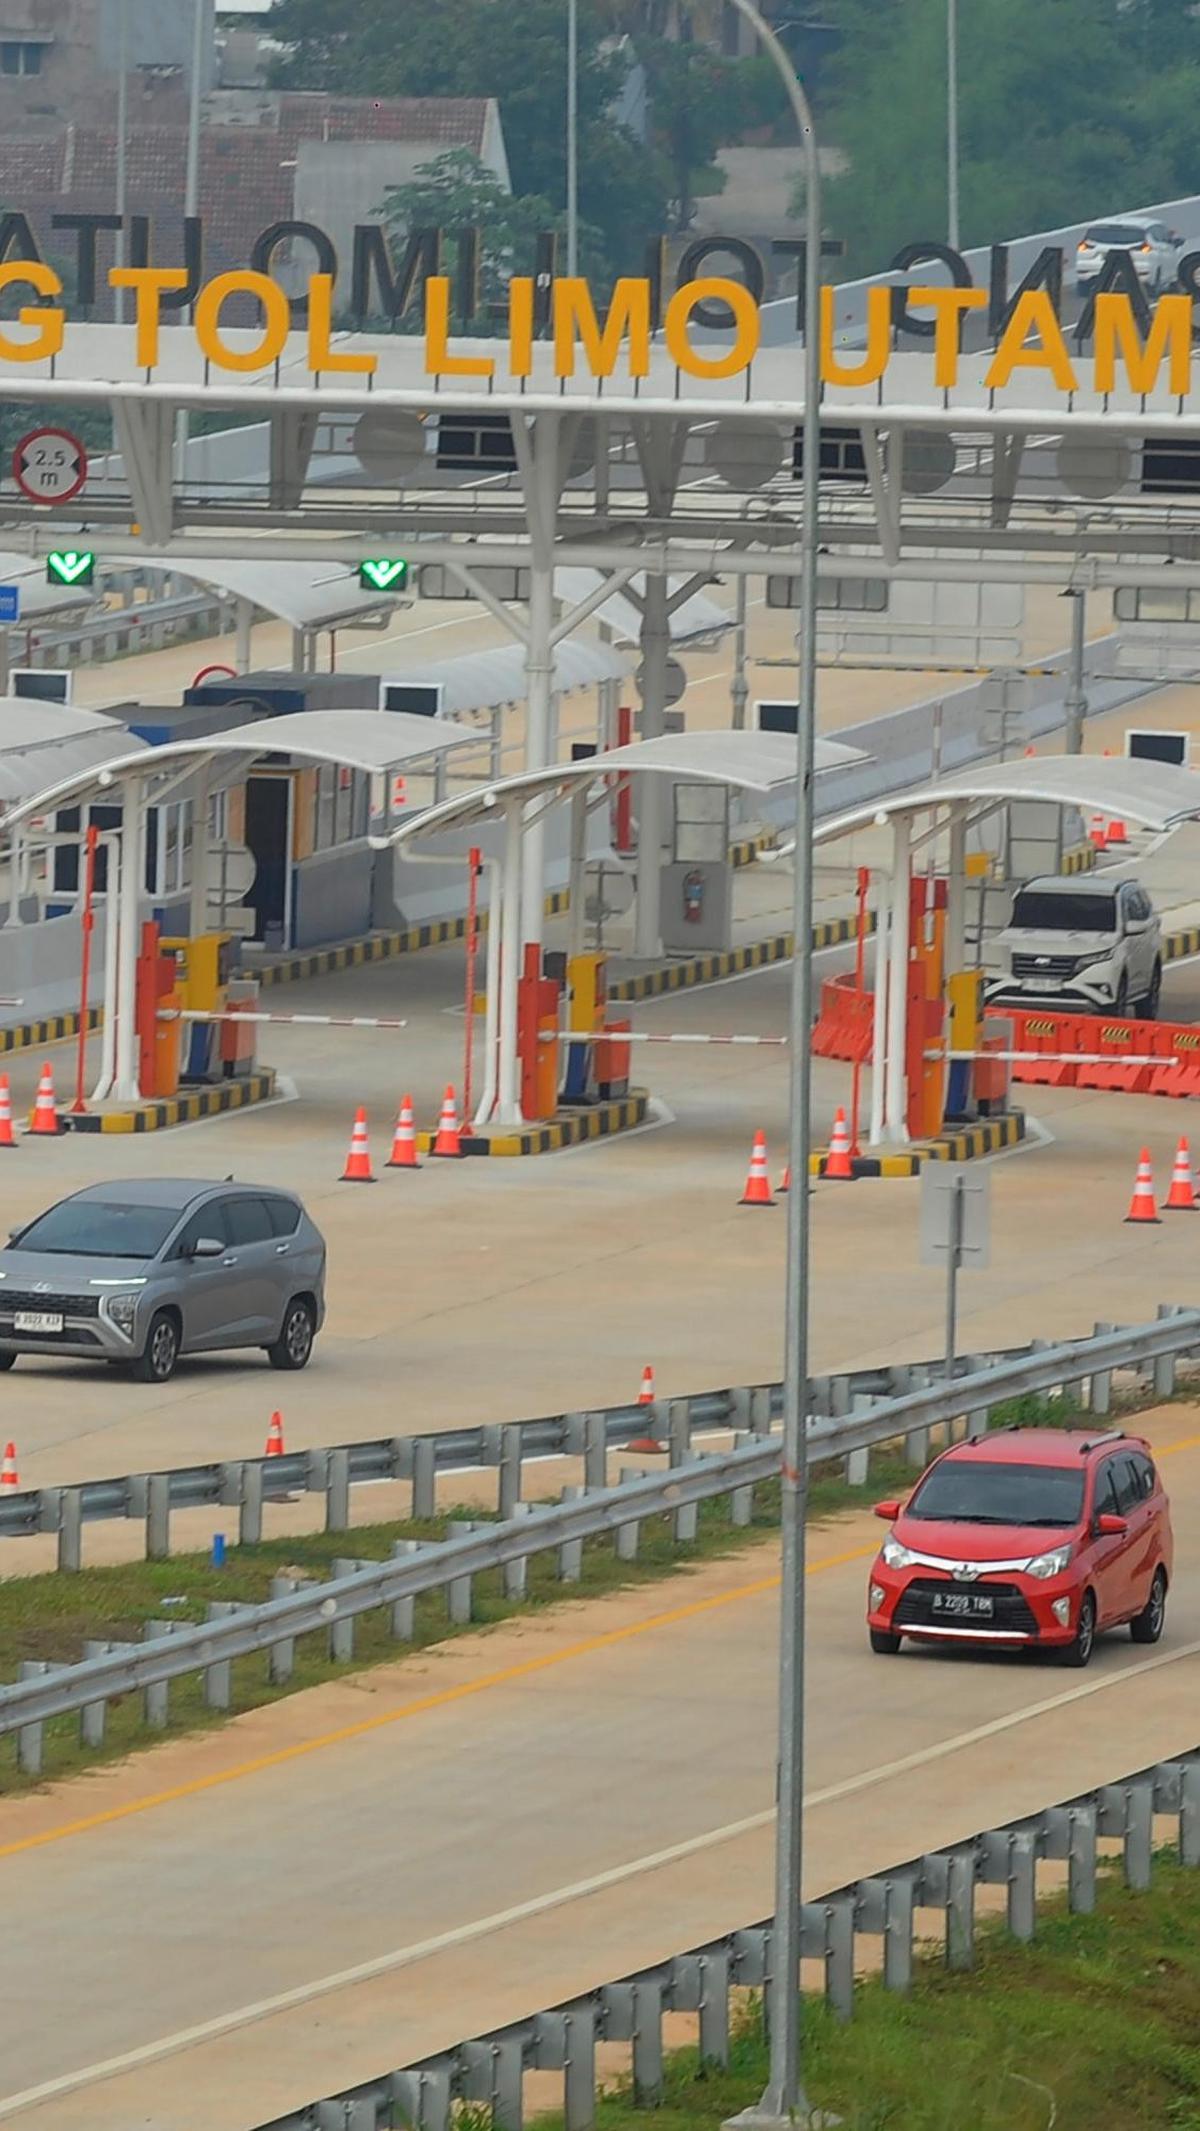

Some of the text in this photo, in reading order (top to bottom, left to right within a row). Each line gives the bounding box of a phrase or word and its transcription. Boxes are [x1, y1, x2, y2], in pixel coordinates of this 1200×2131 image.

[108, 268, 377, 372] TOL
[425, 275, 761, 379] LIMO
[35, 449, 65, 466] 2.5
[41, 472, 58, 486] m
